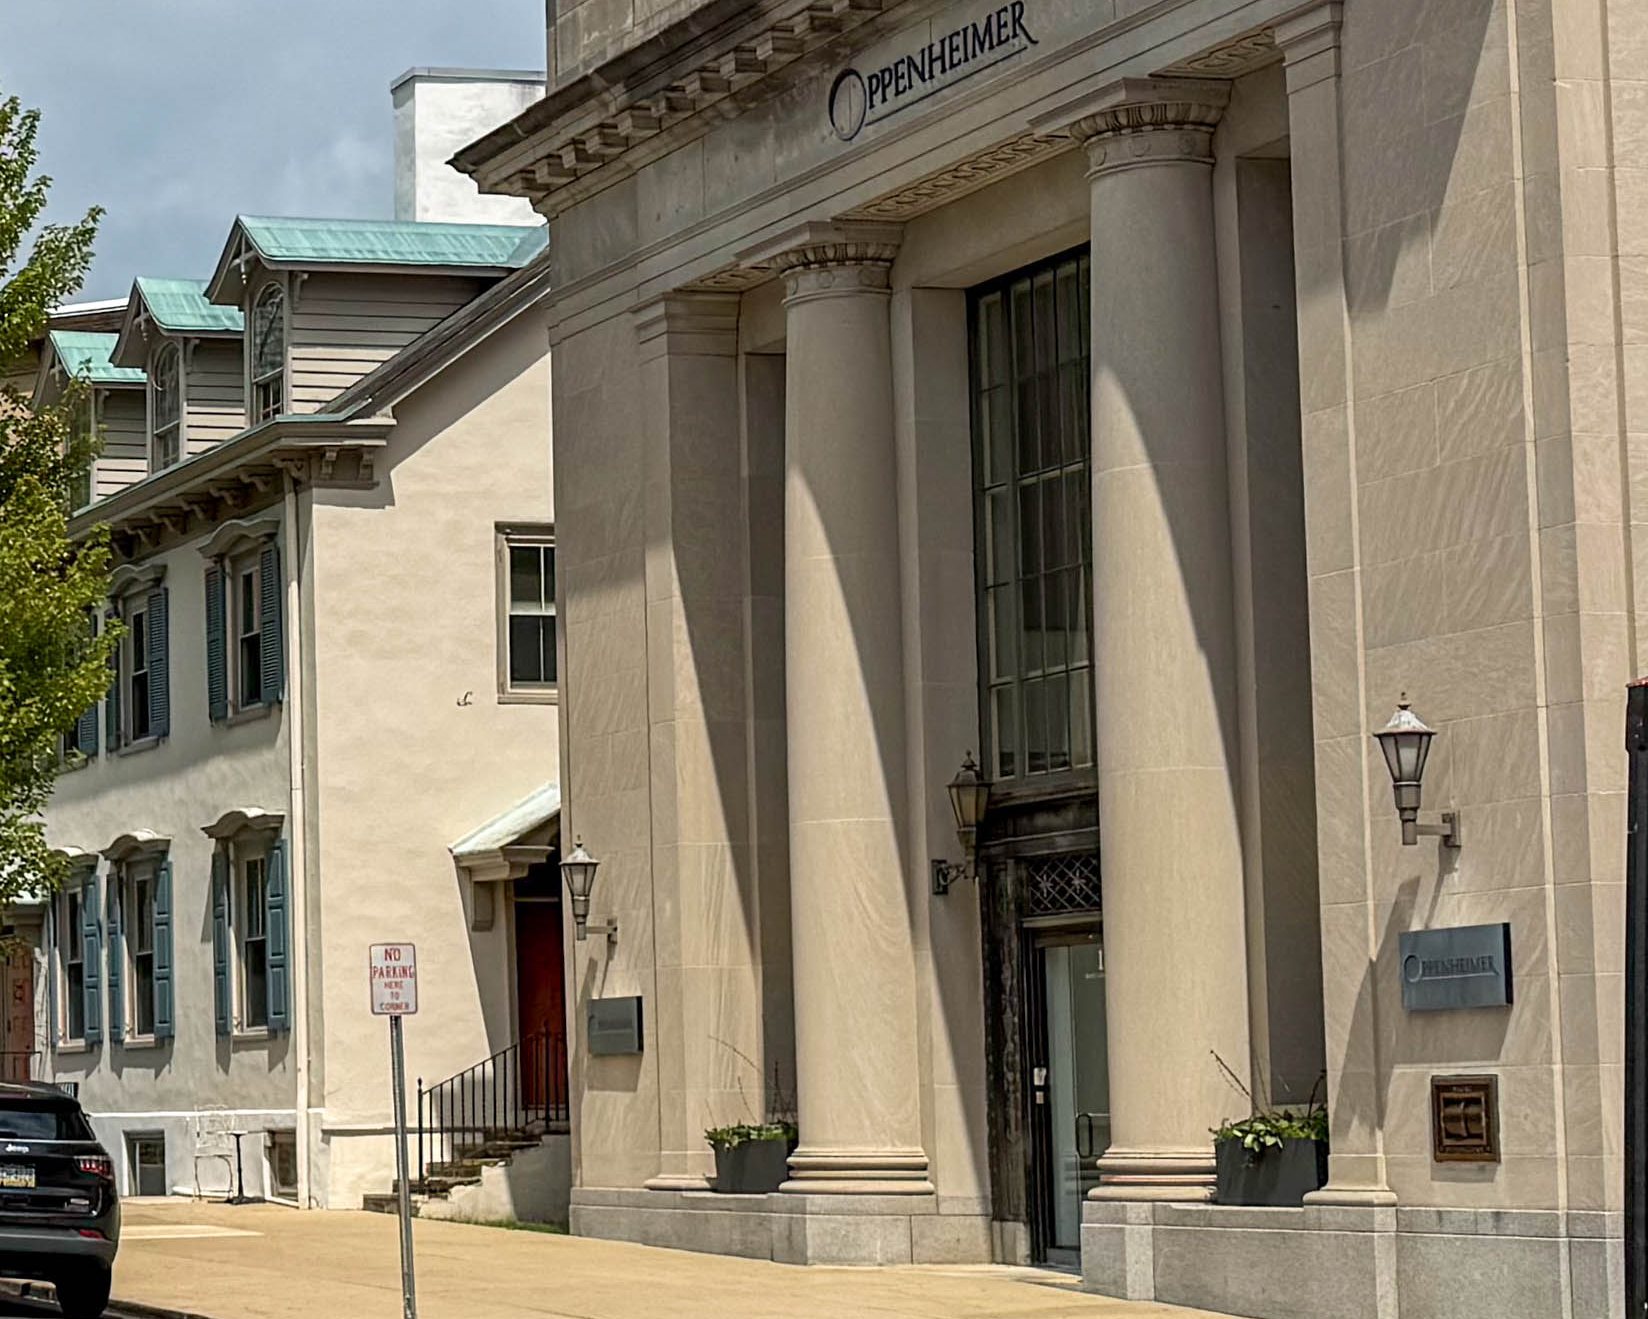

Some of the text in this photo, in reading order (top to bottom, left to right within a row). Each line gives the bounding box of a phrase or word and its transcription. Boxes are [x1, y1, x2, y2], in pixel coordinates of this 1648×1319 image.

[828, 0, 1040, 142] OPPENHEIMER
[384, 948, 401, 961] NO
[373, 965, 415, 979] PARKING
[1404, 954, 1501, 983] OPPENHEIMER
[384, 980, 404, 989] HERE
[390, 991, 400, 1000] TO
[379, 1002, 409, 1011] CORNER
